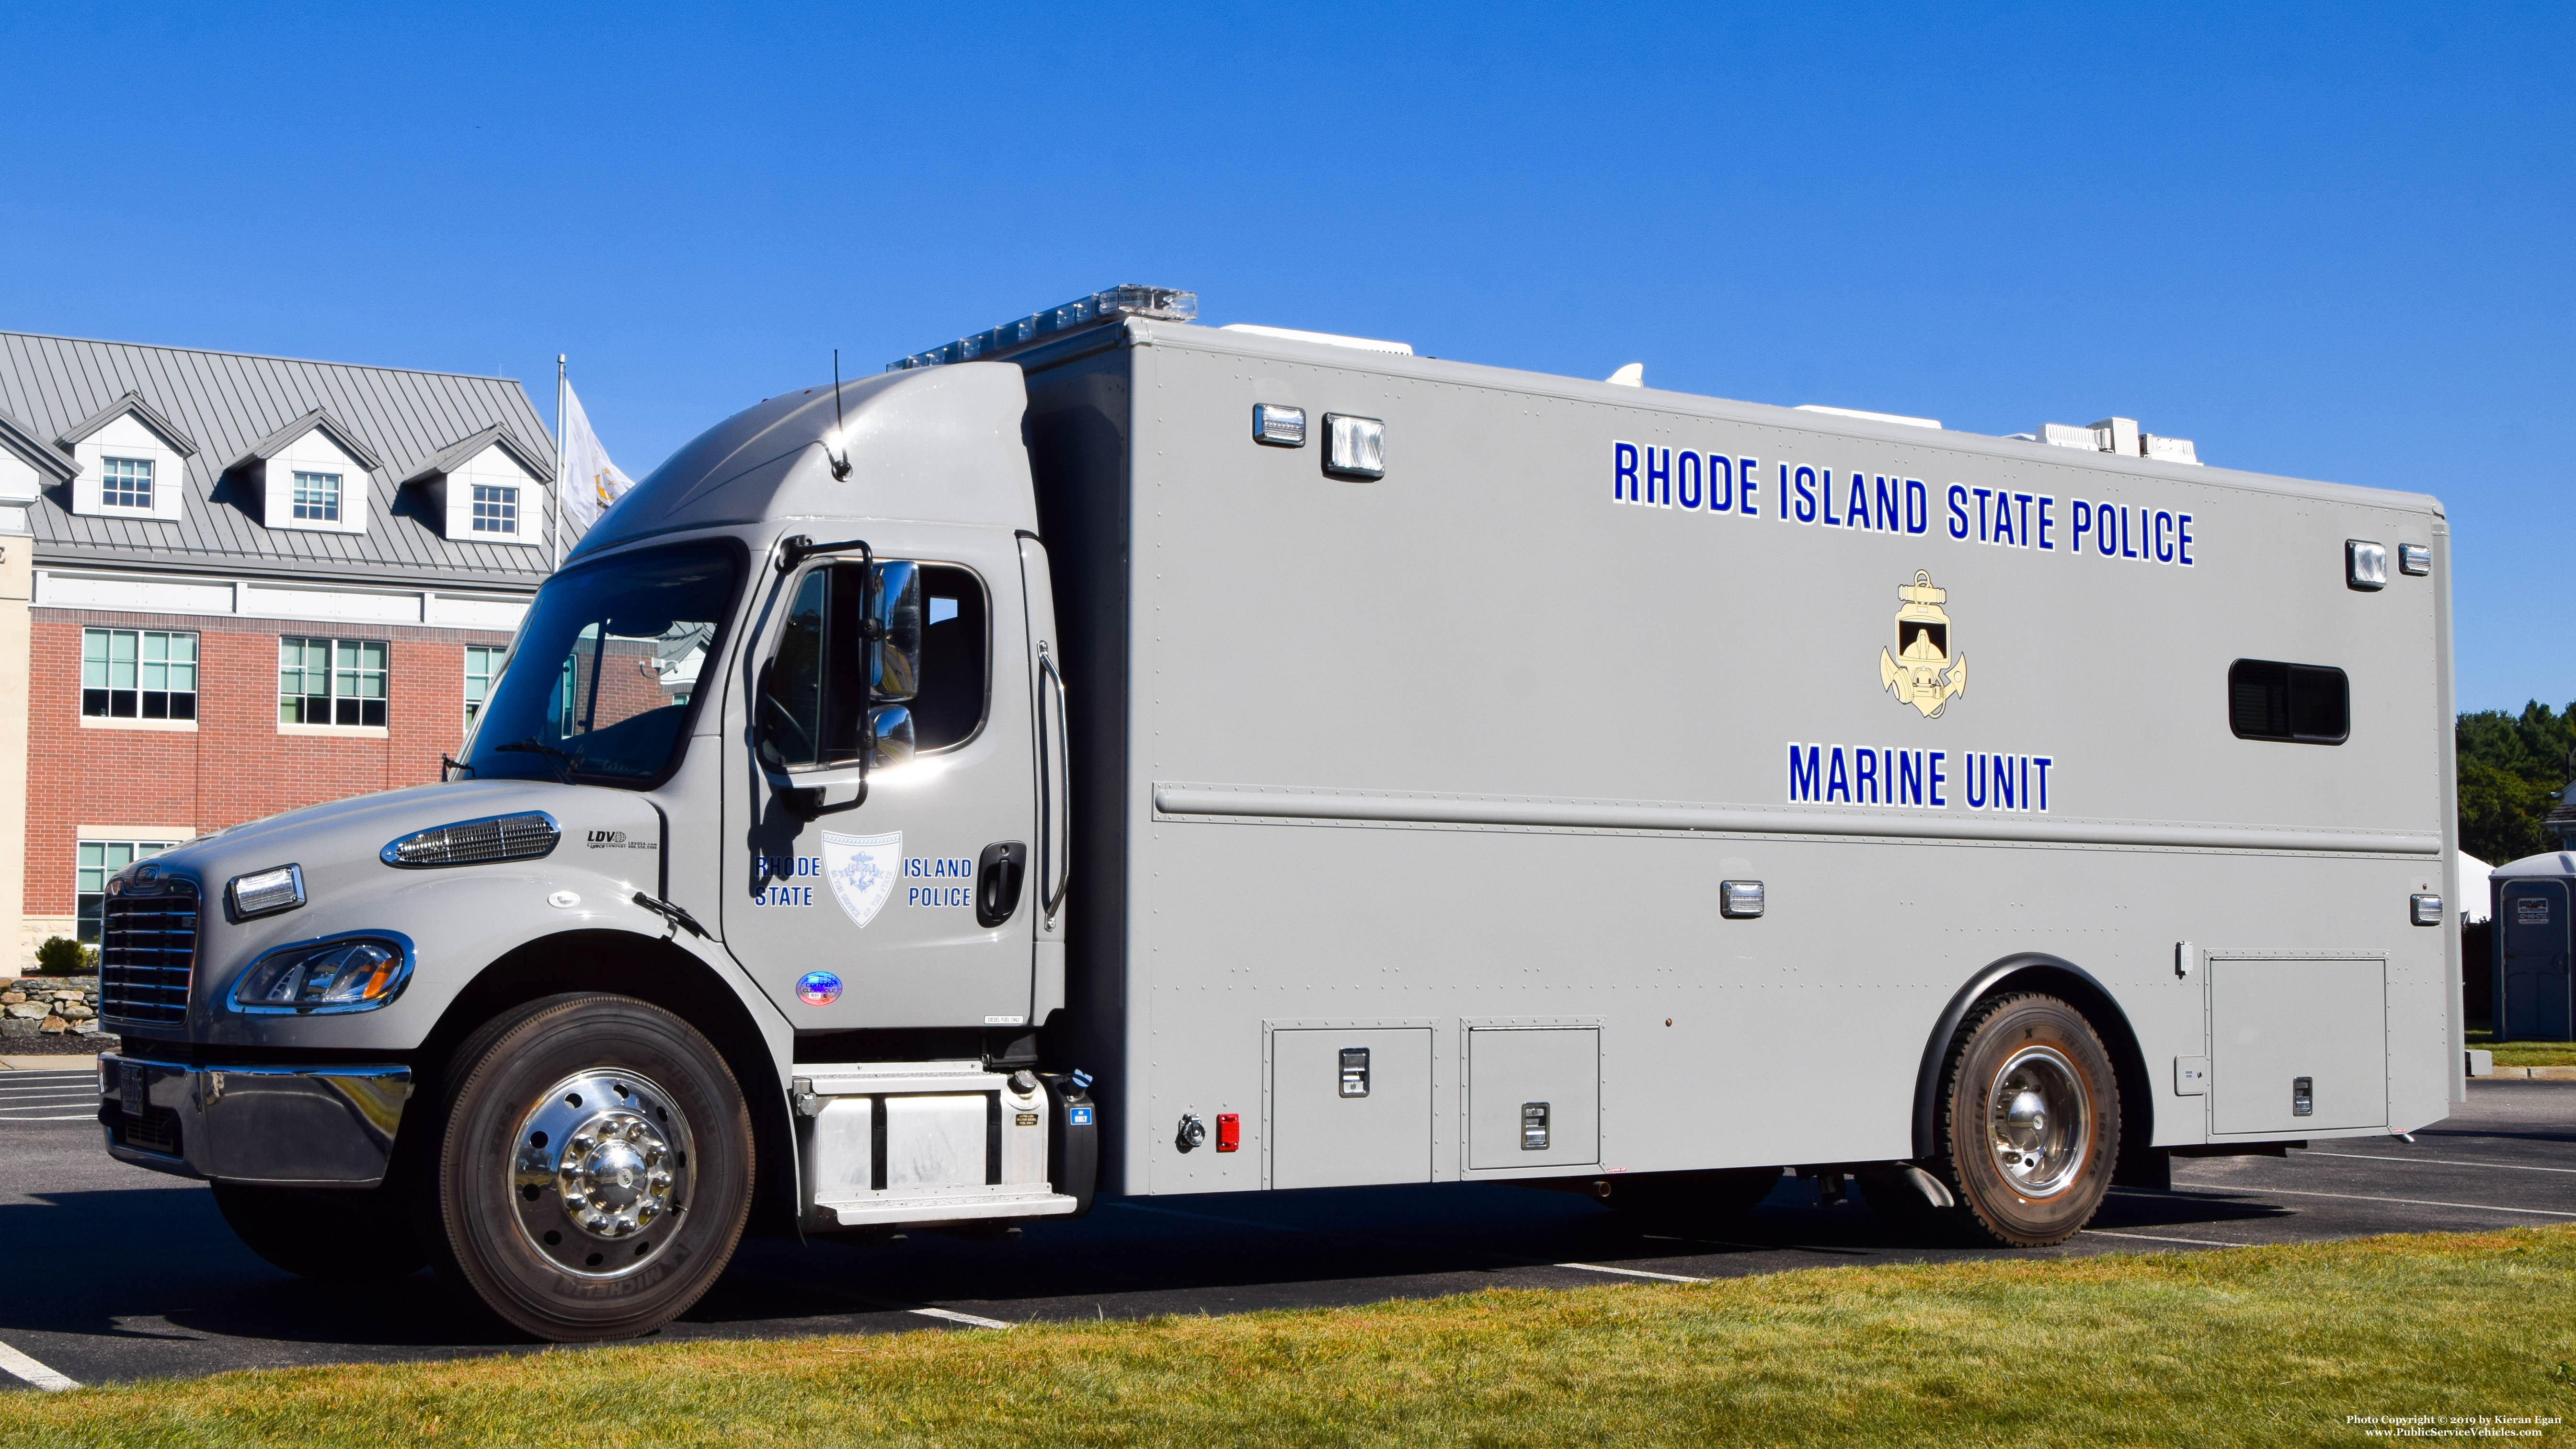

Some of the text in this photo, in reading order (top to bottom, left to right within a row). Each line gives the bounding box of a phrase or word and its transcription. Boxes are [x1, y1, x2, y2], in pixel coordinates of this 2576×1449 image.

[1614, 441, 2194, 567] RHODE ISLAND STATE POLICE
[1787, 742, 2053, 813] MARINE UNIT
[587, 830, 615, 842] LDV
[755, 856, 972, 878] RHODE ISLAND
[755, 886, 971, 907] STATE POLICE
[554, 1264, 663, 1298] MICHELIN
